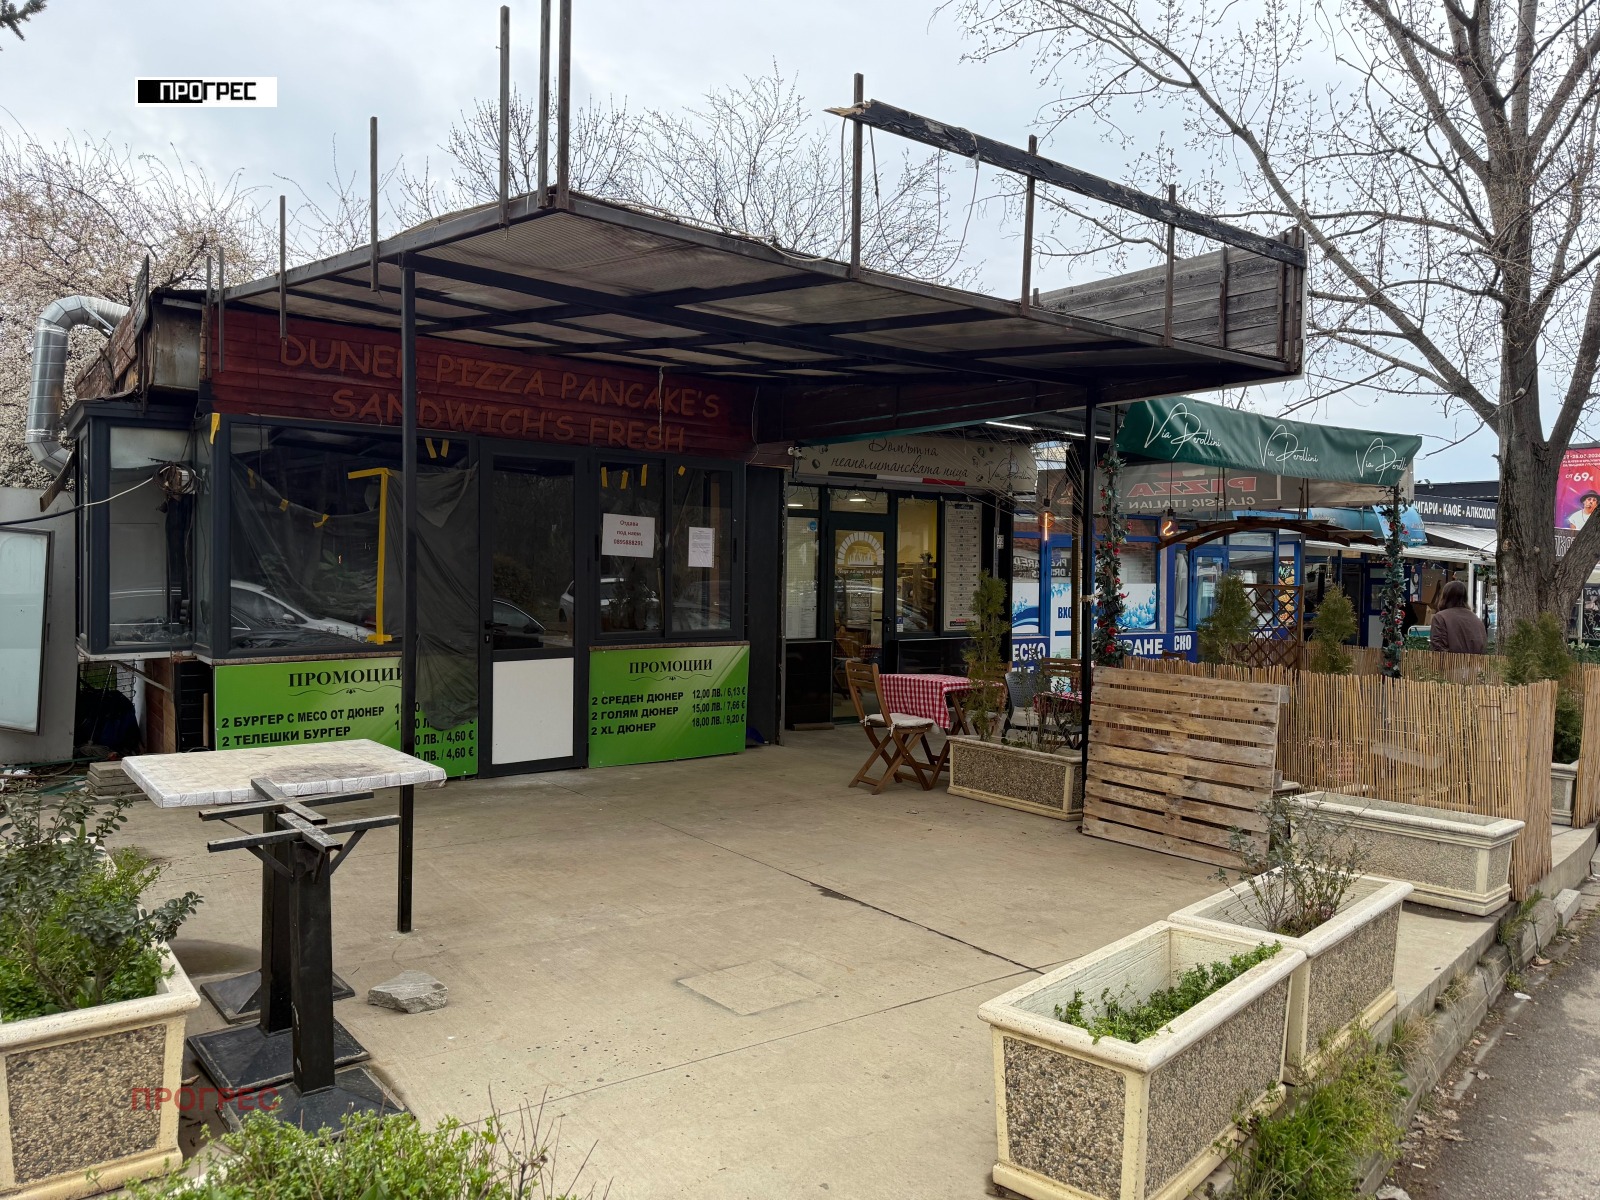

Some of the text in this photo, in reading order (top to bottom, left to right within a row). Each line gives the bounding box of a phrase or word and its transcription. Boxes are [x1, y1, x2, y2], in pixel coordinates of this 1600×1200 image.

[436, 354, 543, 397] PIZZA
[559, 372, 721, 418] PANCAKE'S
[330, 389, 686, 452] SANDWICH'S FRESH
[1144, 402, 1187, 449] Via
[1257, 424, 1287, 467] Via
[1355, 437, 1384, 478] Via
[1443, 503, 1462, 517] КАФЕ
[1465, 506, 1496, 520] АЛКОХОЛ
[1057, 606, 1072, 619] ВХО
[1117, 638, 1164, 656] РАНЕ
[629, 659, 713, 674] ПРОМОЦИИ
[591, 696, 598, 706] 2
[601, 694, 644, 705] СРЕДЕН
[646, 692, 684, 704] ДЮНЕР
[692, 688, 710, 700] 12,00
[711, 687, 723, 698] ЛВ.
[727, 686, 741, 697] 6,13
[222, 717, 230, 729] 2
[233, 713, 285, 728] БУРГЕР
[286, 712, 295, 723] С
[297, 709, 328, 723] МЕСО
[330, 708, 345, 720] ОТ
[347, 706, 385, 720] ДЮНЕР
[591, 711, 598, 721] 2
[601, 709, 639, 720] ГОЛЯМ
[641, 706, 679, 719] ДЮНЕР
[692, 702, 710, 714] 15,00
[711, 701, 723, 712] ЛВ.
[726, 700, 740, 712] 7,66
[591, 726, 598, 736] 2
[600, 725, 614, 735] XL
[617, 722, 656, 735] ДЮНЕР
[692, 717, 710, 728] 18,00
[710, 715, 722, 726] ЛВ.
[726, 714, 740, 726] 9,20
[222, 726, 351, 748] 2 ТЕЛЕШКИ БУРГЕР
[422, 733, 440, 745] ЛВ.
[446, 730, 466, 745] 4,60
[468, 729, 474, 741] €
[422, 750, 440, 762] ЛВ.
[446, 746, 466, 761] 4,60
[468, 746, 474, 757] €
